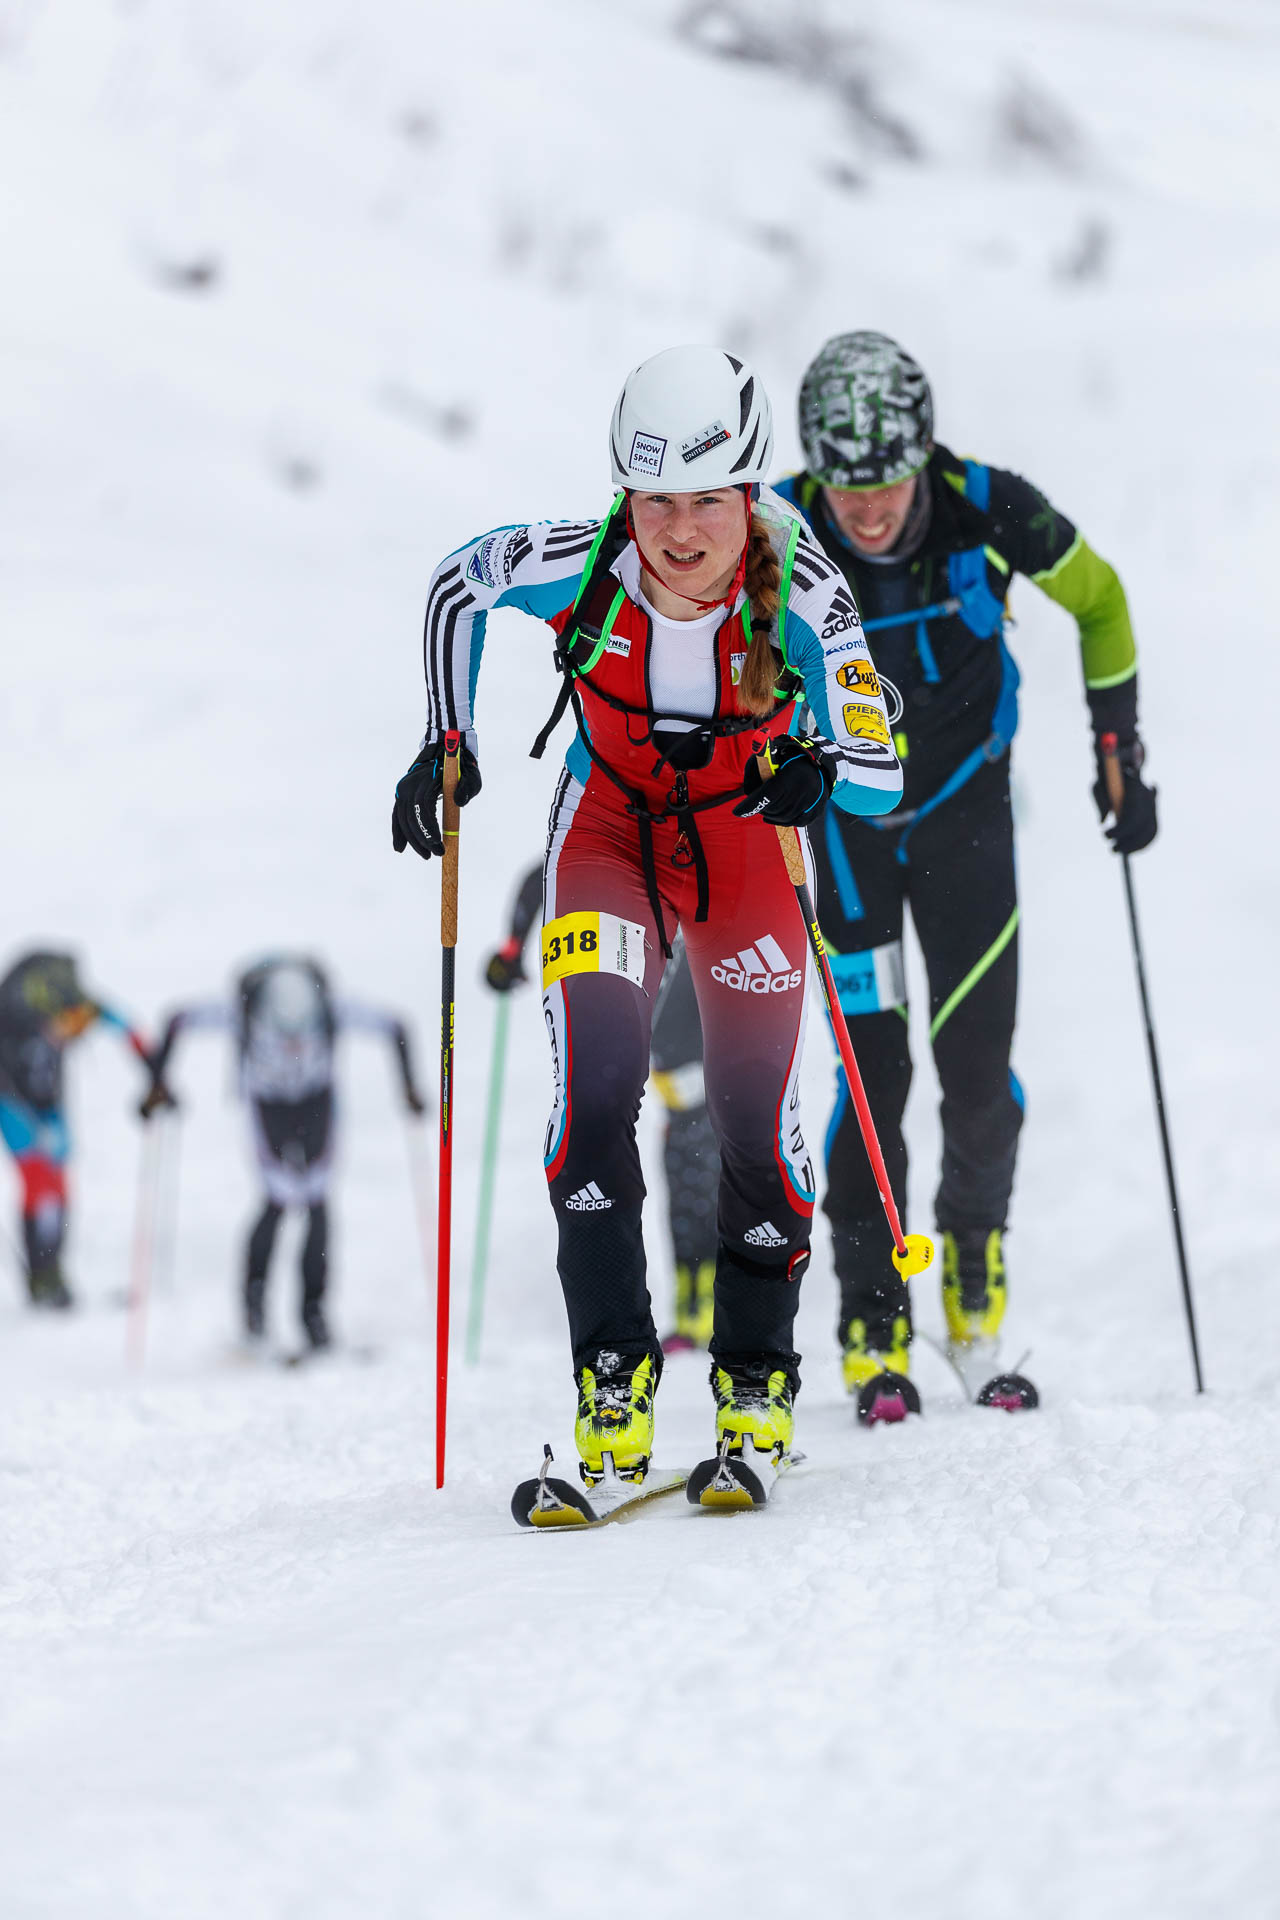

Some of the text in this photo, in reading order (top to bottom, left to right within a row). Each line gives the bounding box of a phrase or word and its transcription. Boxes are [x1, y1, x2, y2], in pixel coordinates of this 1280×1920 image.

[682, 425, 719, 450] MAYR
[636, 441, 661, 455] SNOW
[684, 444, 706, 460] UNITED
[633, 453, 659, 467] SPACE
[821, 611, 861, 640] adid
[846, 705, 884, 720] PIEPS
[811, 920, 826, 956] LEKI
[710, 965, 802, 994] adidas
[565, 1199, 612, 1211] adidas
[744, 1232, 789, 1248] adidas
